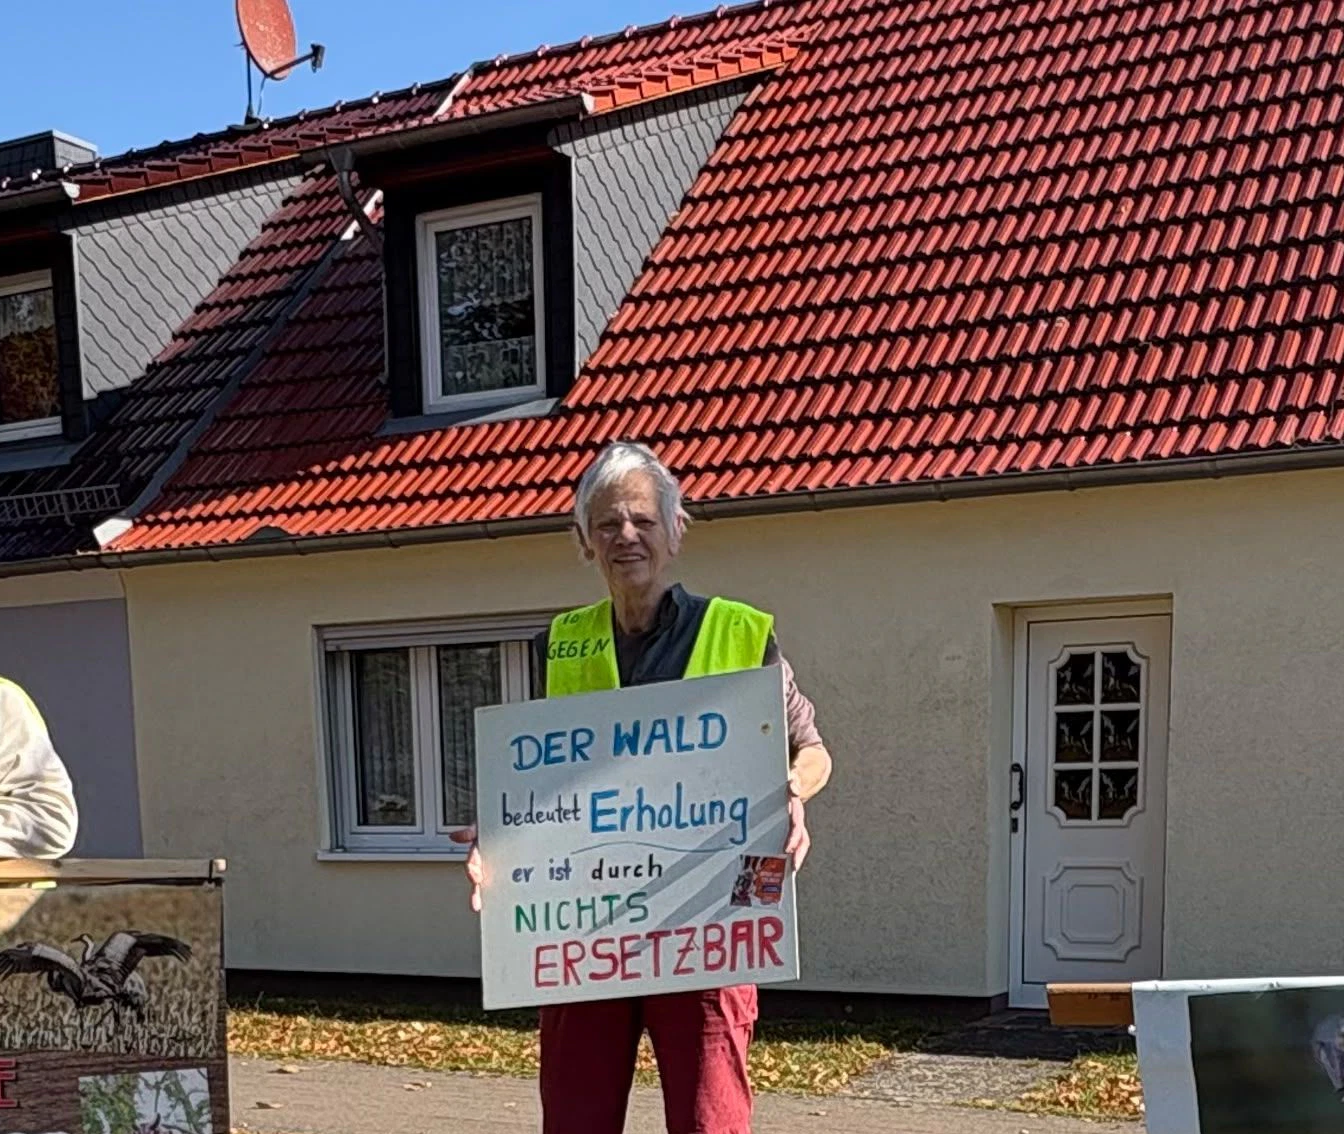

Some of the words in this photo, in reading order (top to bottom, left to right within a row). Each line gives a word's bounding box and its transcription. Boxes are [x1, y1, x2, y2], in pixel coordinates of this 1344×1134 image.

[510, 728, 595, 770] DER
[613, 713, 728, 756] WALD
[503, 793, 581, 827] bedeutet
[590, 783, 749, 845] Erholung
[512, 865, 530, 884] er
[549, 859, 572, 880] ist
[592, 855, 664, 880] durch
[515, 892, 649, 934] NICHTS
[534, 916, 785, 988] ERSETZBAR
